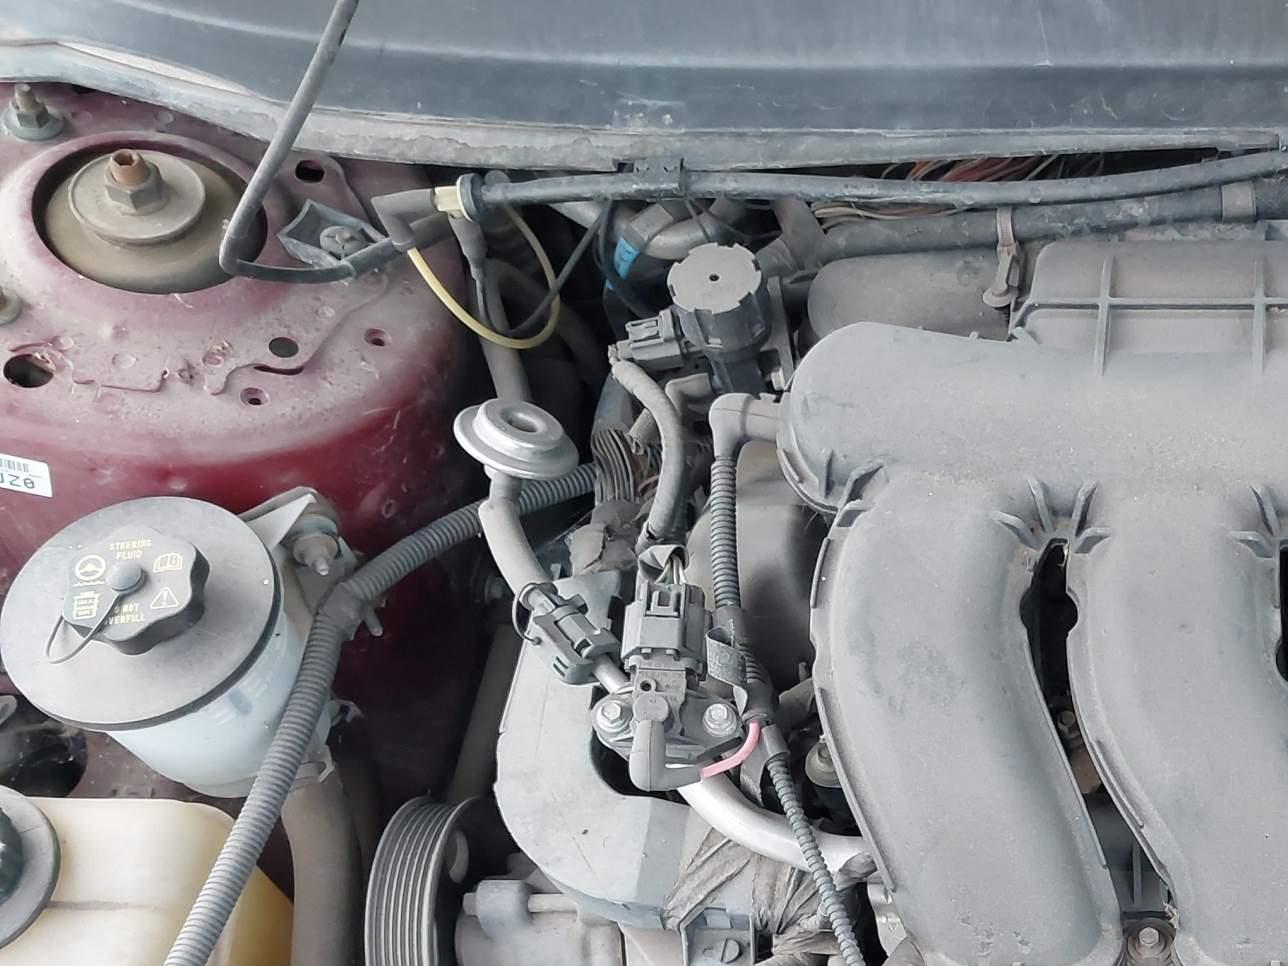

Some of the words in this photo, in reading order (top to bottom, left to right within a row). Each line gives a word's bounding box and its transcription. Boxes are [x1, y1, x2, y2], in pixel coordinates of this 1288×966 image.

[109, 539, 152, 550] STEERING
[116, 550, 142, 560] FLUID
[122, 603, 140, 613] NOT
[106, 613, 146, 625] VERFILL
